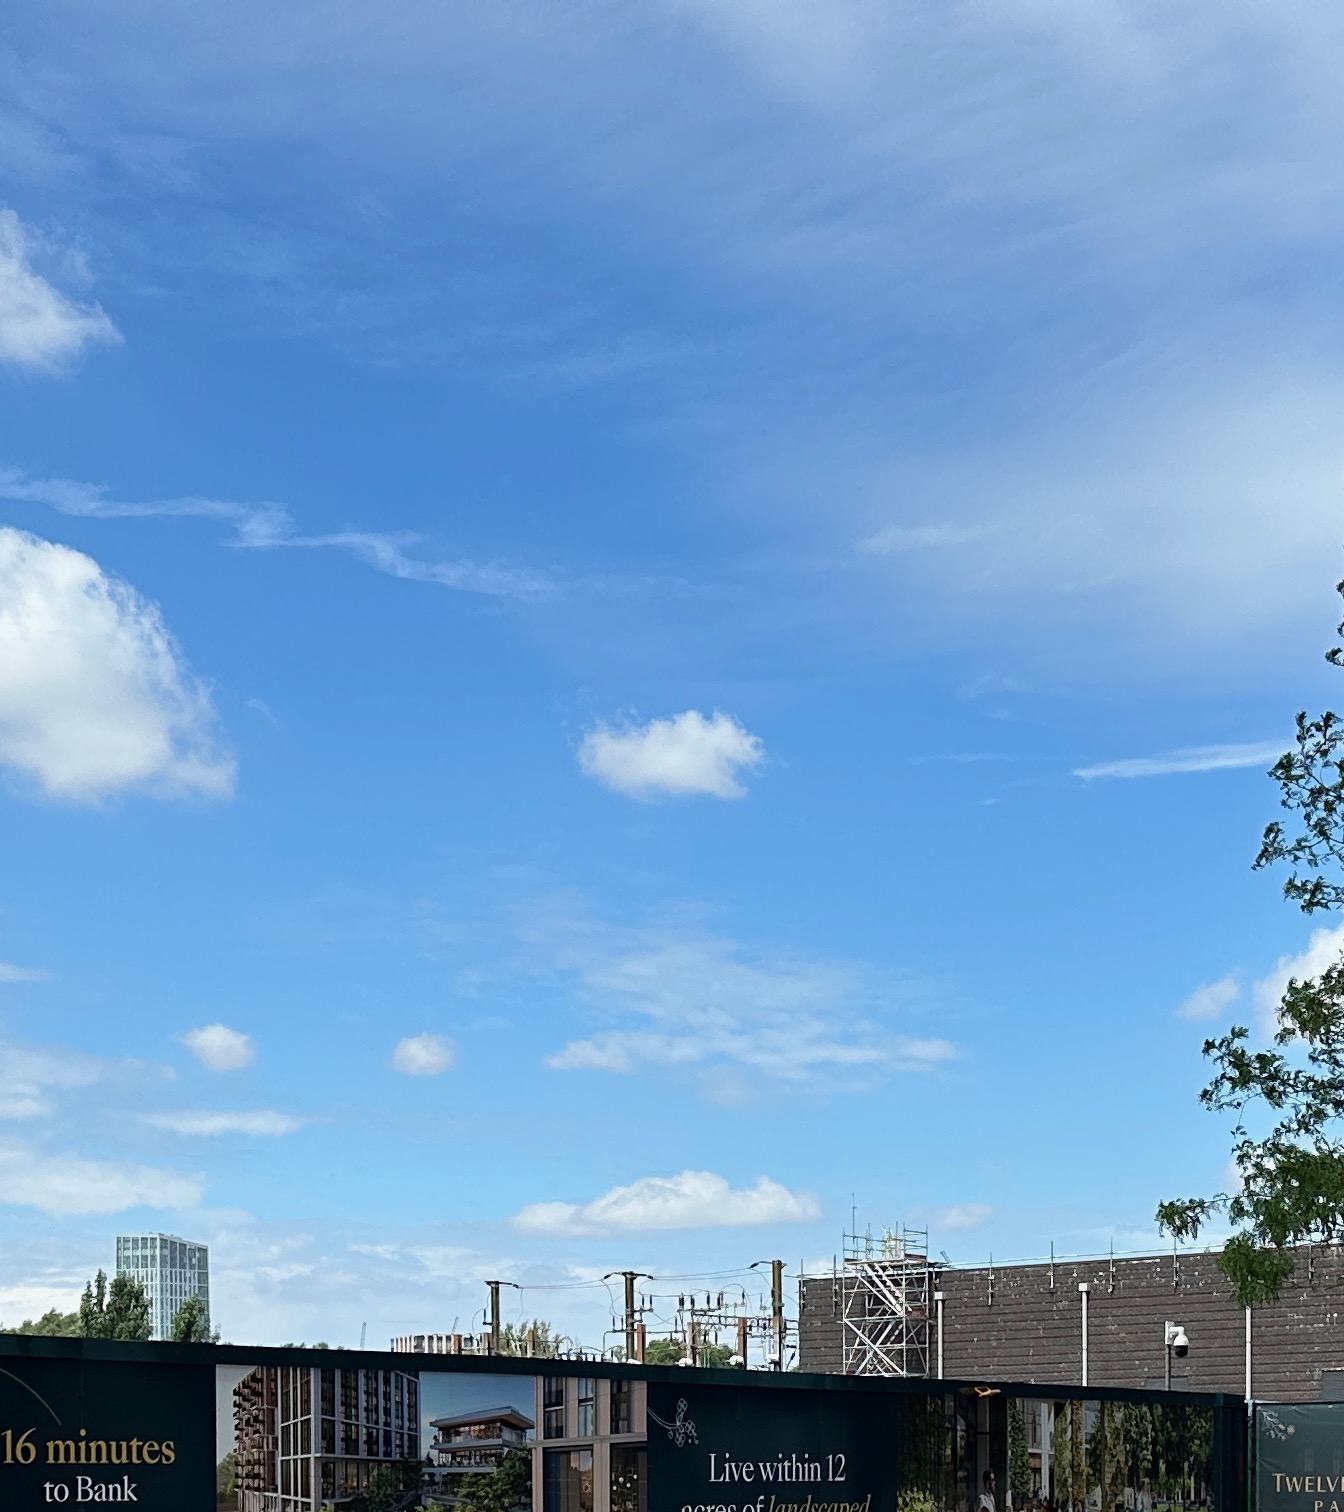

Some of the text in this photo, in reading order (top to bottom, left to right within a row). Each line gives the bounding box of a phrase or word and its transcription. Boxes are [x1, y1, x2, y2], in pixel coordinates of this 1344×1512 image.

[1, 1428, 176, 1464] 16 minutes
[708, 1453, 846, 1482] Live within 12
[43, 1474, 138, 1503] to Bank
